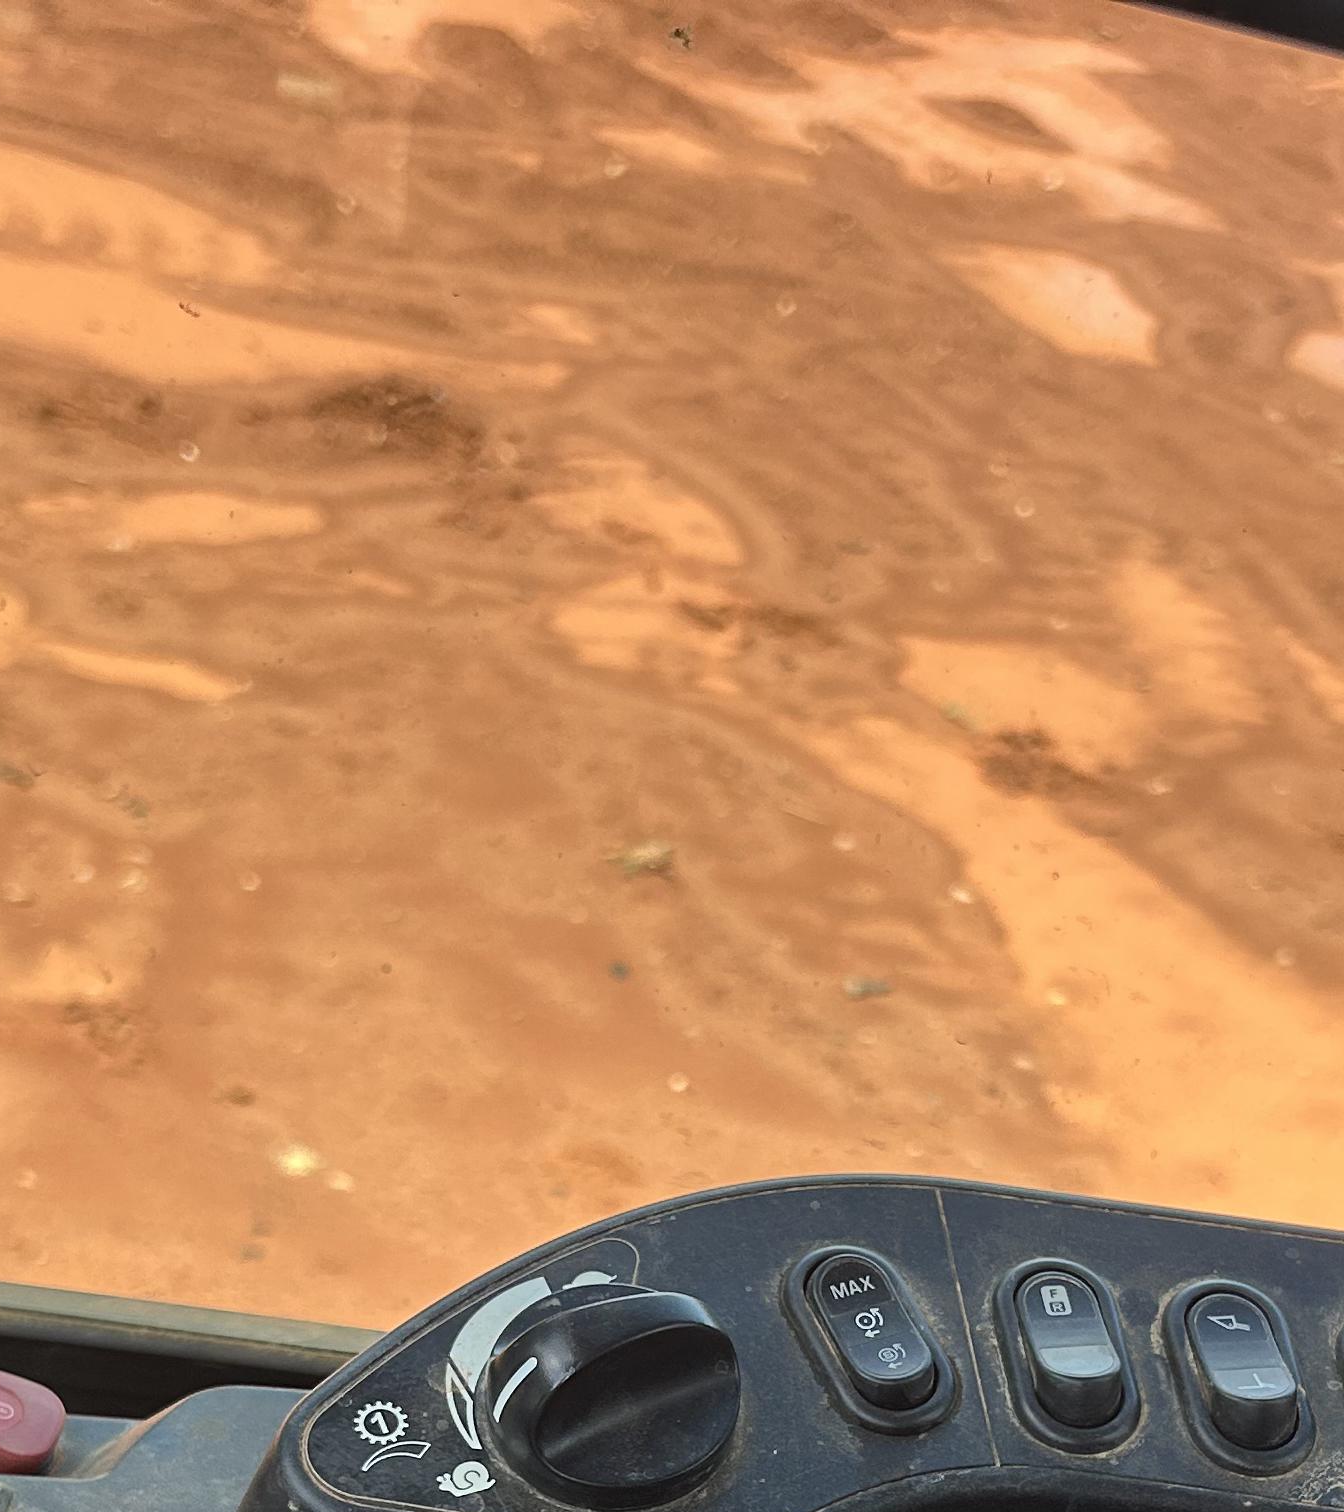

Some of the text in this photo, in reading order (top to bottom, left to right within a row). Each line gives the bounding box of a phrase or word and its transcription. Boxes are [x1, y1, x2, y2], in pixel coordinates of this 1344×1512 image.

[829, 1275, 876, 1300] MAX
[1049, 1288, 1057, 1299] F
[370, 1411, 390, 1434] 1
